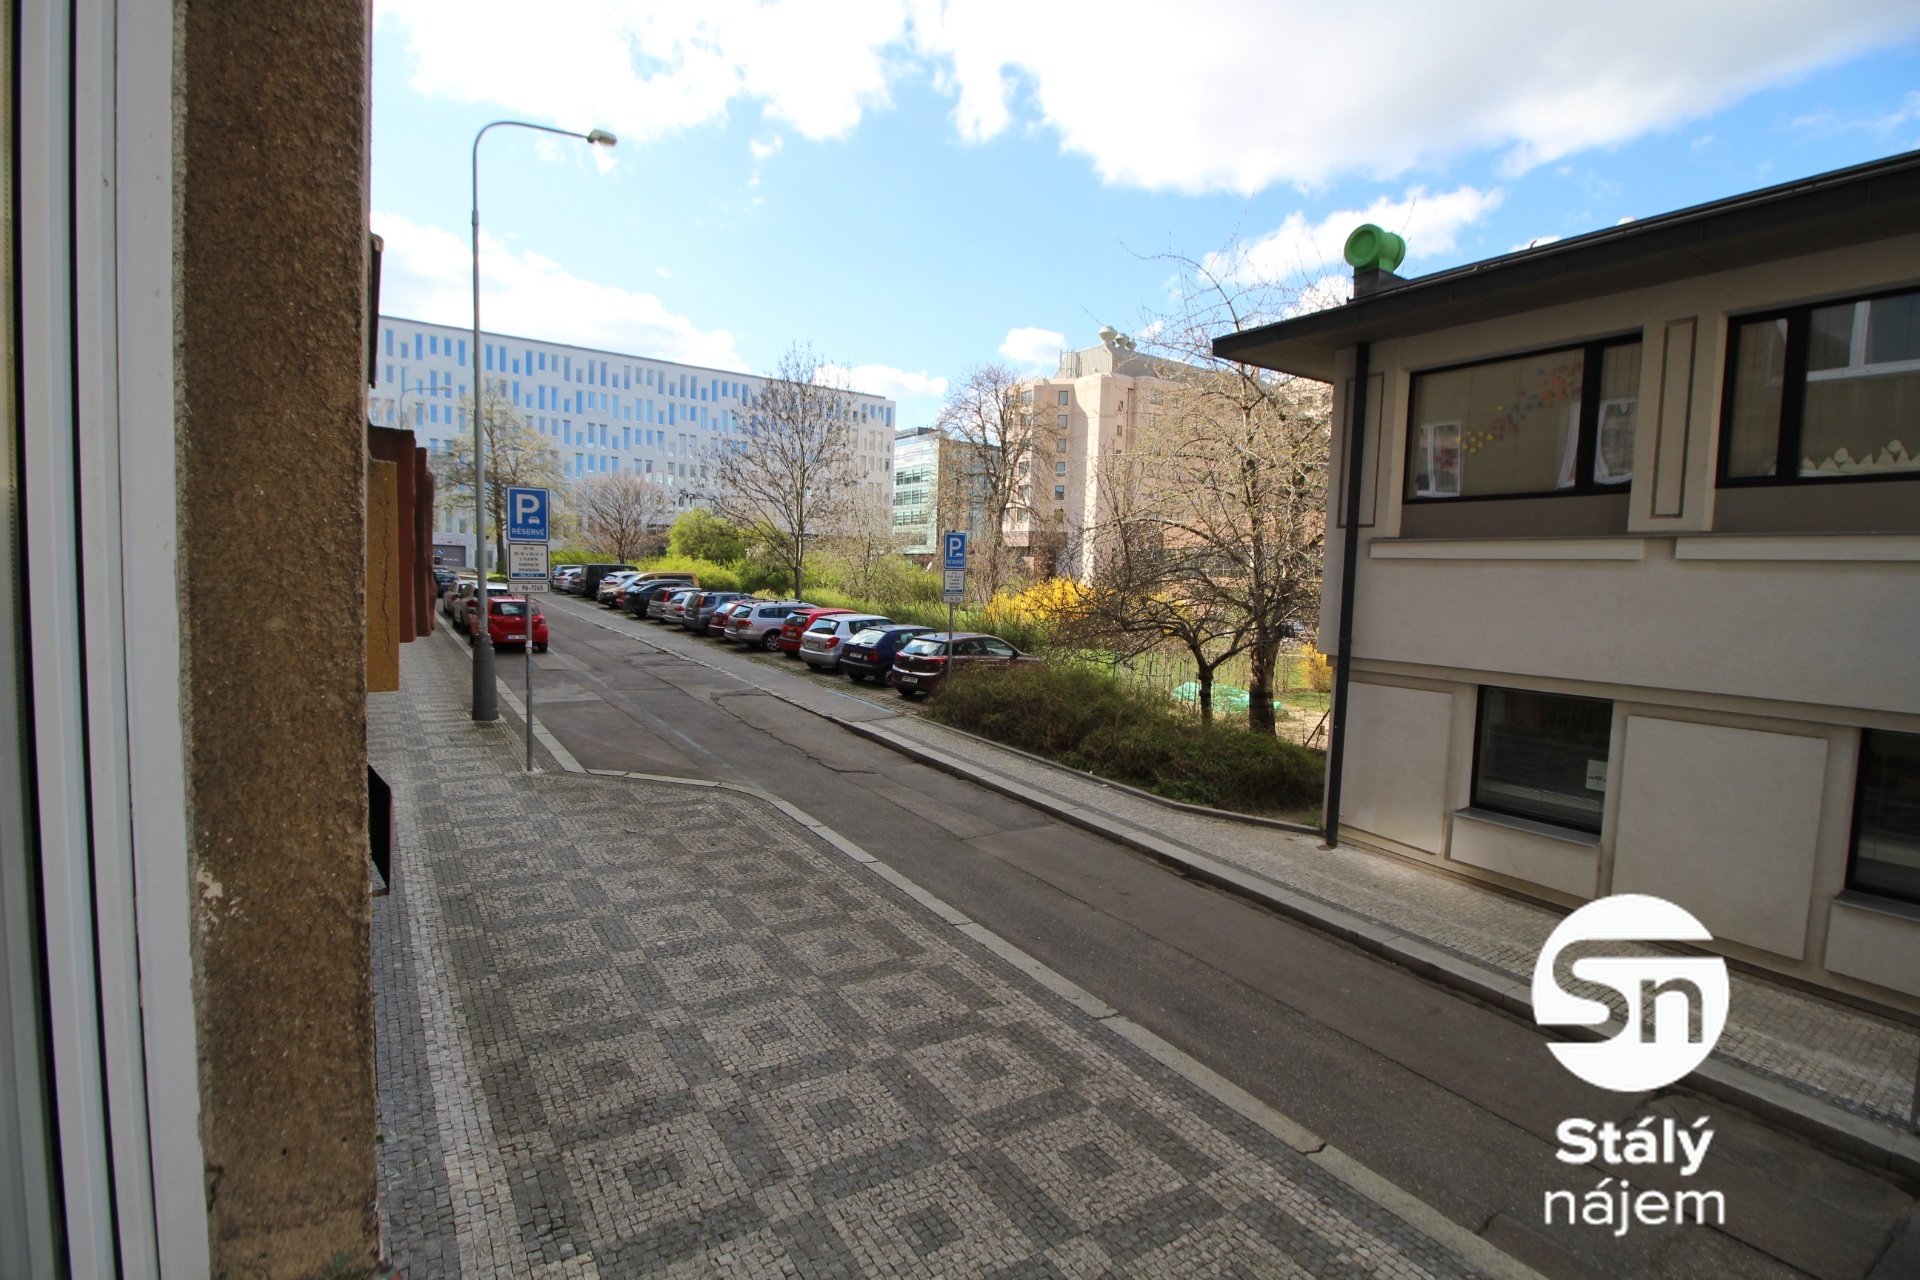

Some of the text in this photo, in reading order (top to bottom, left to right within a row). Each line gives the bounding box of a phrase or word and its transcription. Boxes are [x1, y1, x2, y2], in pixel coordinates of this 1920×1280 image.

[516, 493, 540, 524] P
[511, 526, 545, 536] RÉSERVÉ
[949, 537, 962, 557] P
